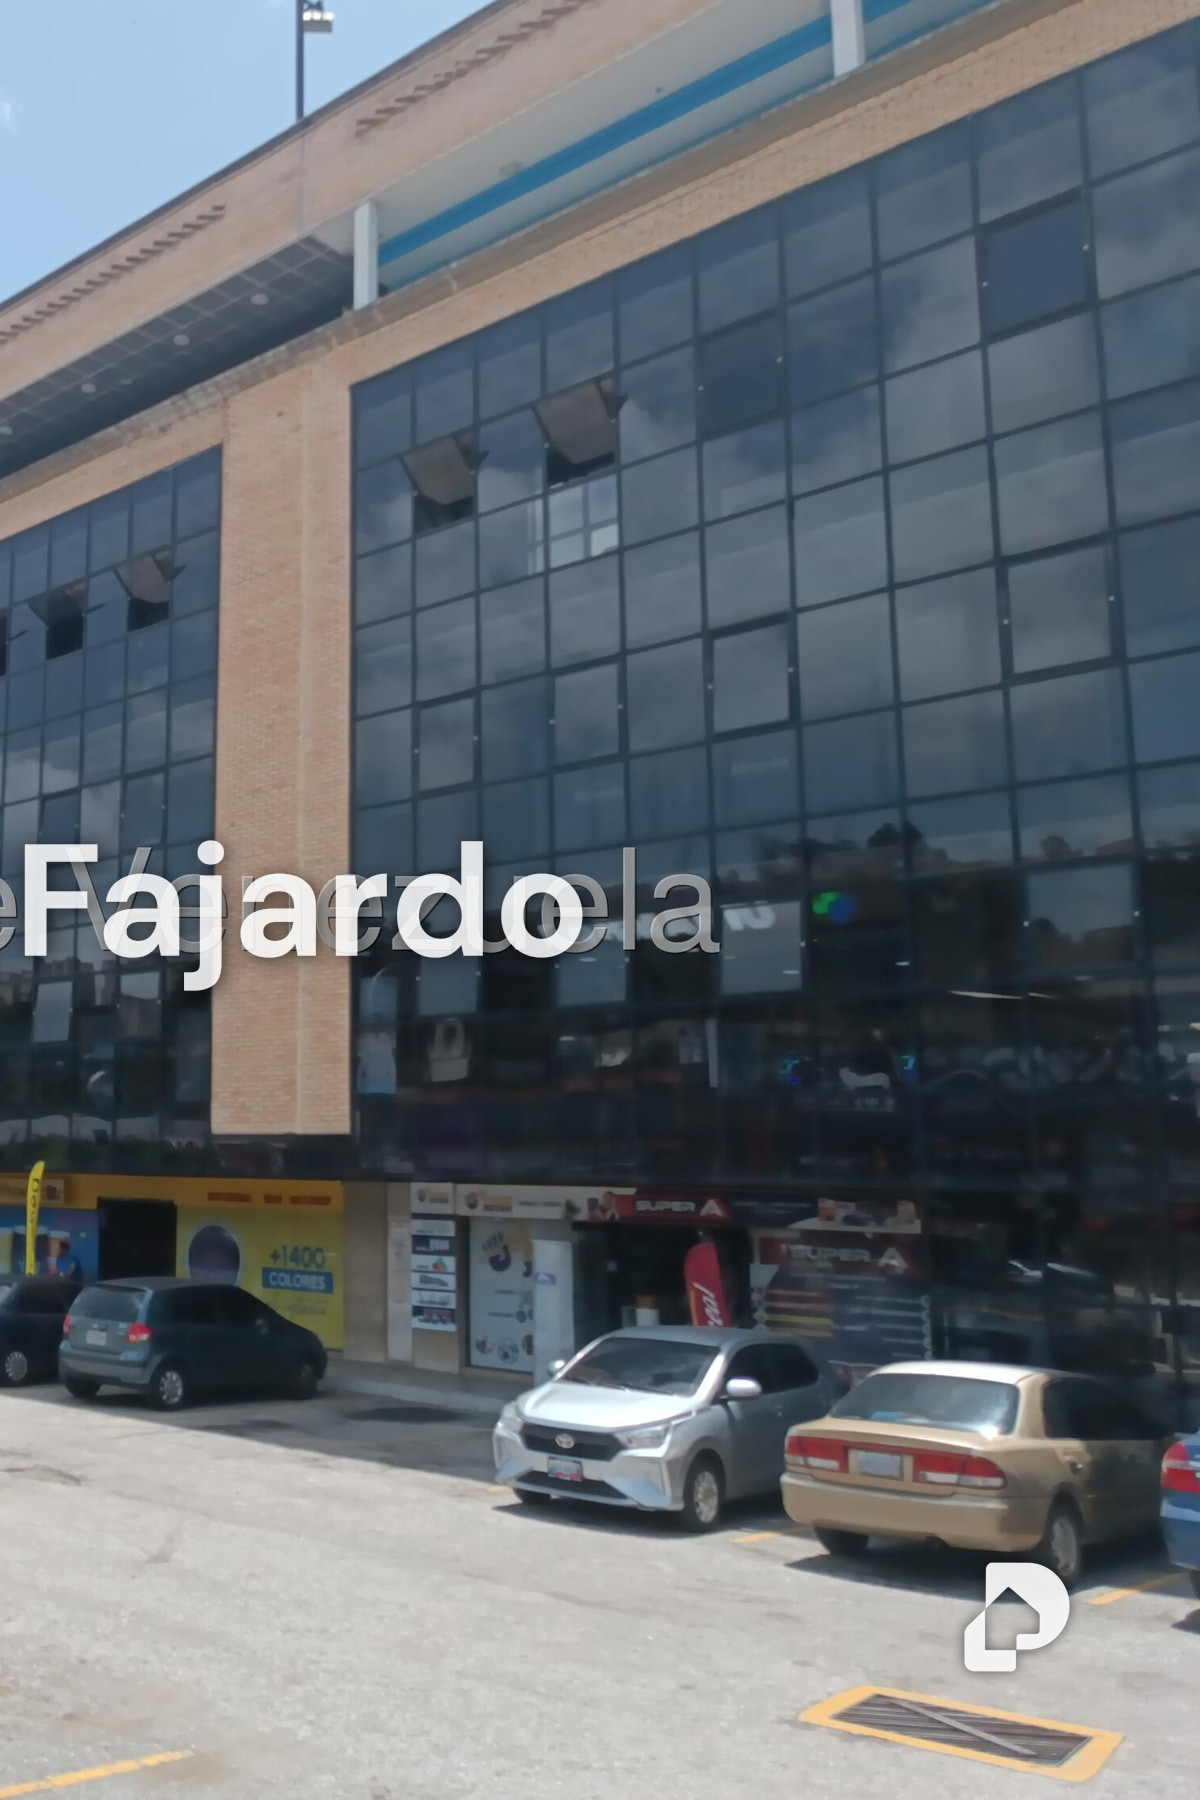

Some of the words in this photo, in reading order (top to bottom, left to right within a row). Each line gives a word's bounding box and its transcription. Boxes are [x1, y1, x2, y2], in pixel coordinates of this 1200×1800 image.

[636, 1201, 696, 1212] SUPER
[270, 1244, 326, 1269] +1400
[268, 1271, 327, 1291] COLORES
